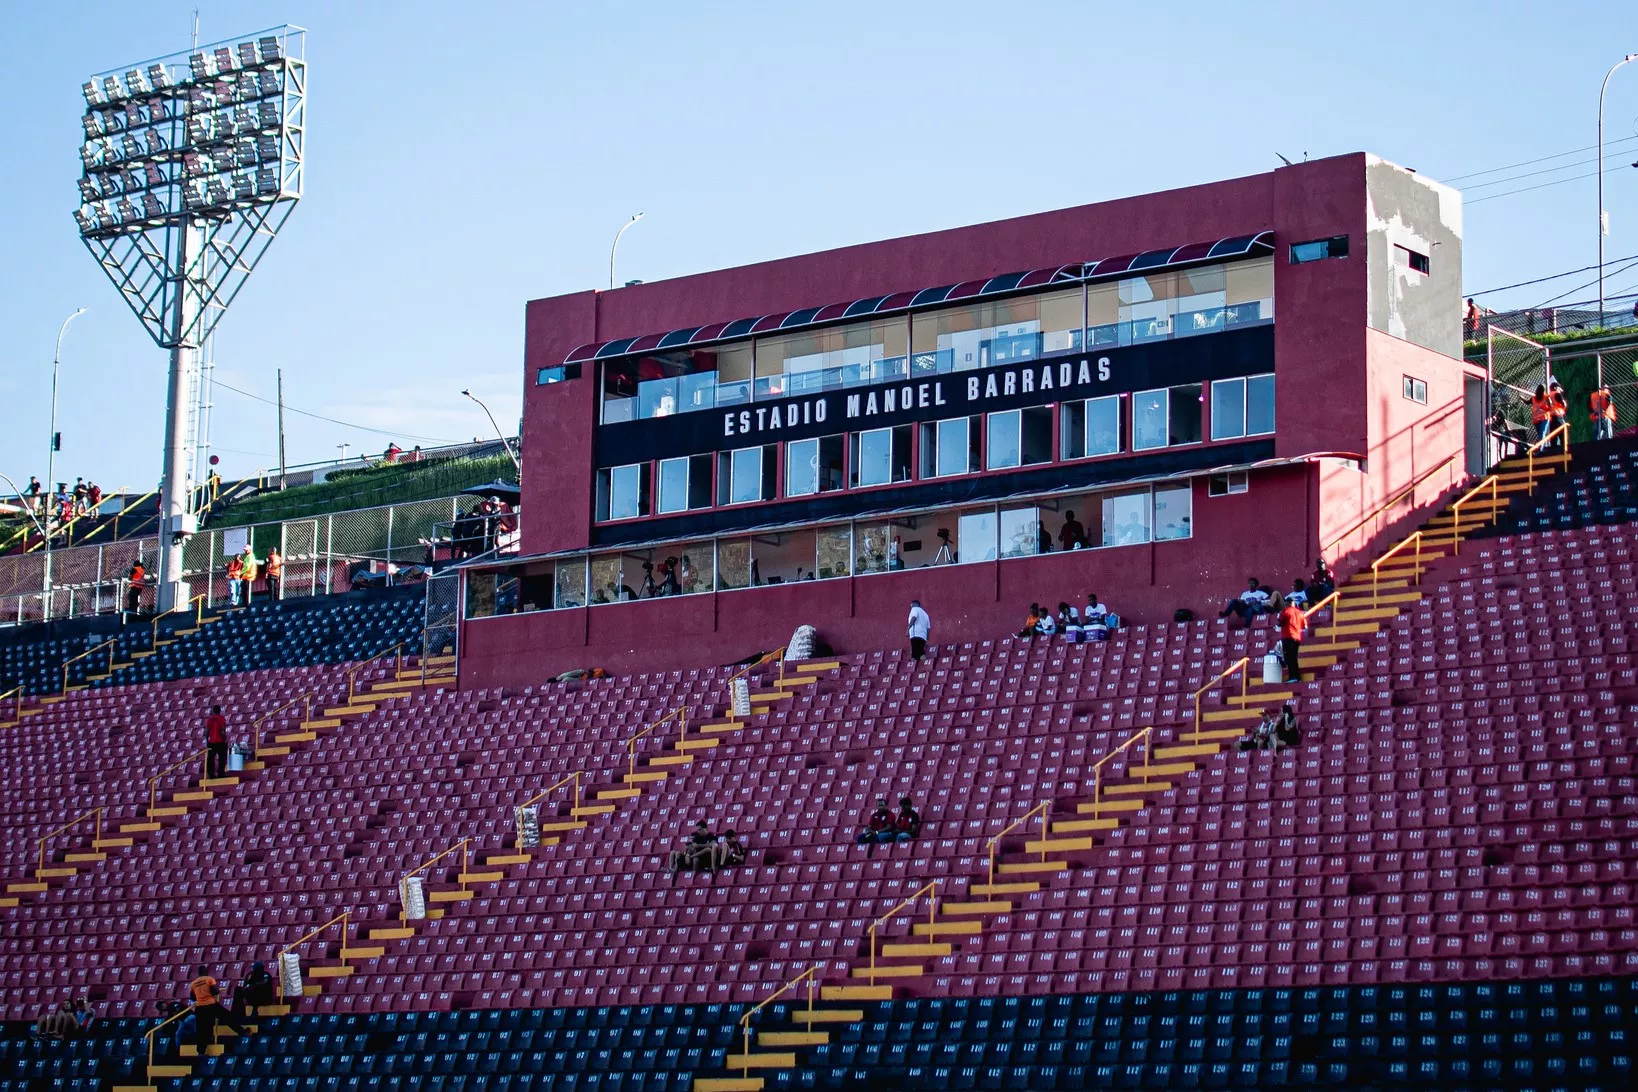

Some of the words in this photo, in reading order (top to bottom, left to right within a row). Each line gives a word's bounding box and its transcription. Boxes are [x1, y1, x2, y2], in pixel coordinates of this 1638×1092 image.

[724, 398, 827, 437] ESTADIO
[846, 382, 946, 418] MANOEL
[967, 357, 1111, 401] BARRADAS
